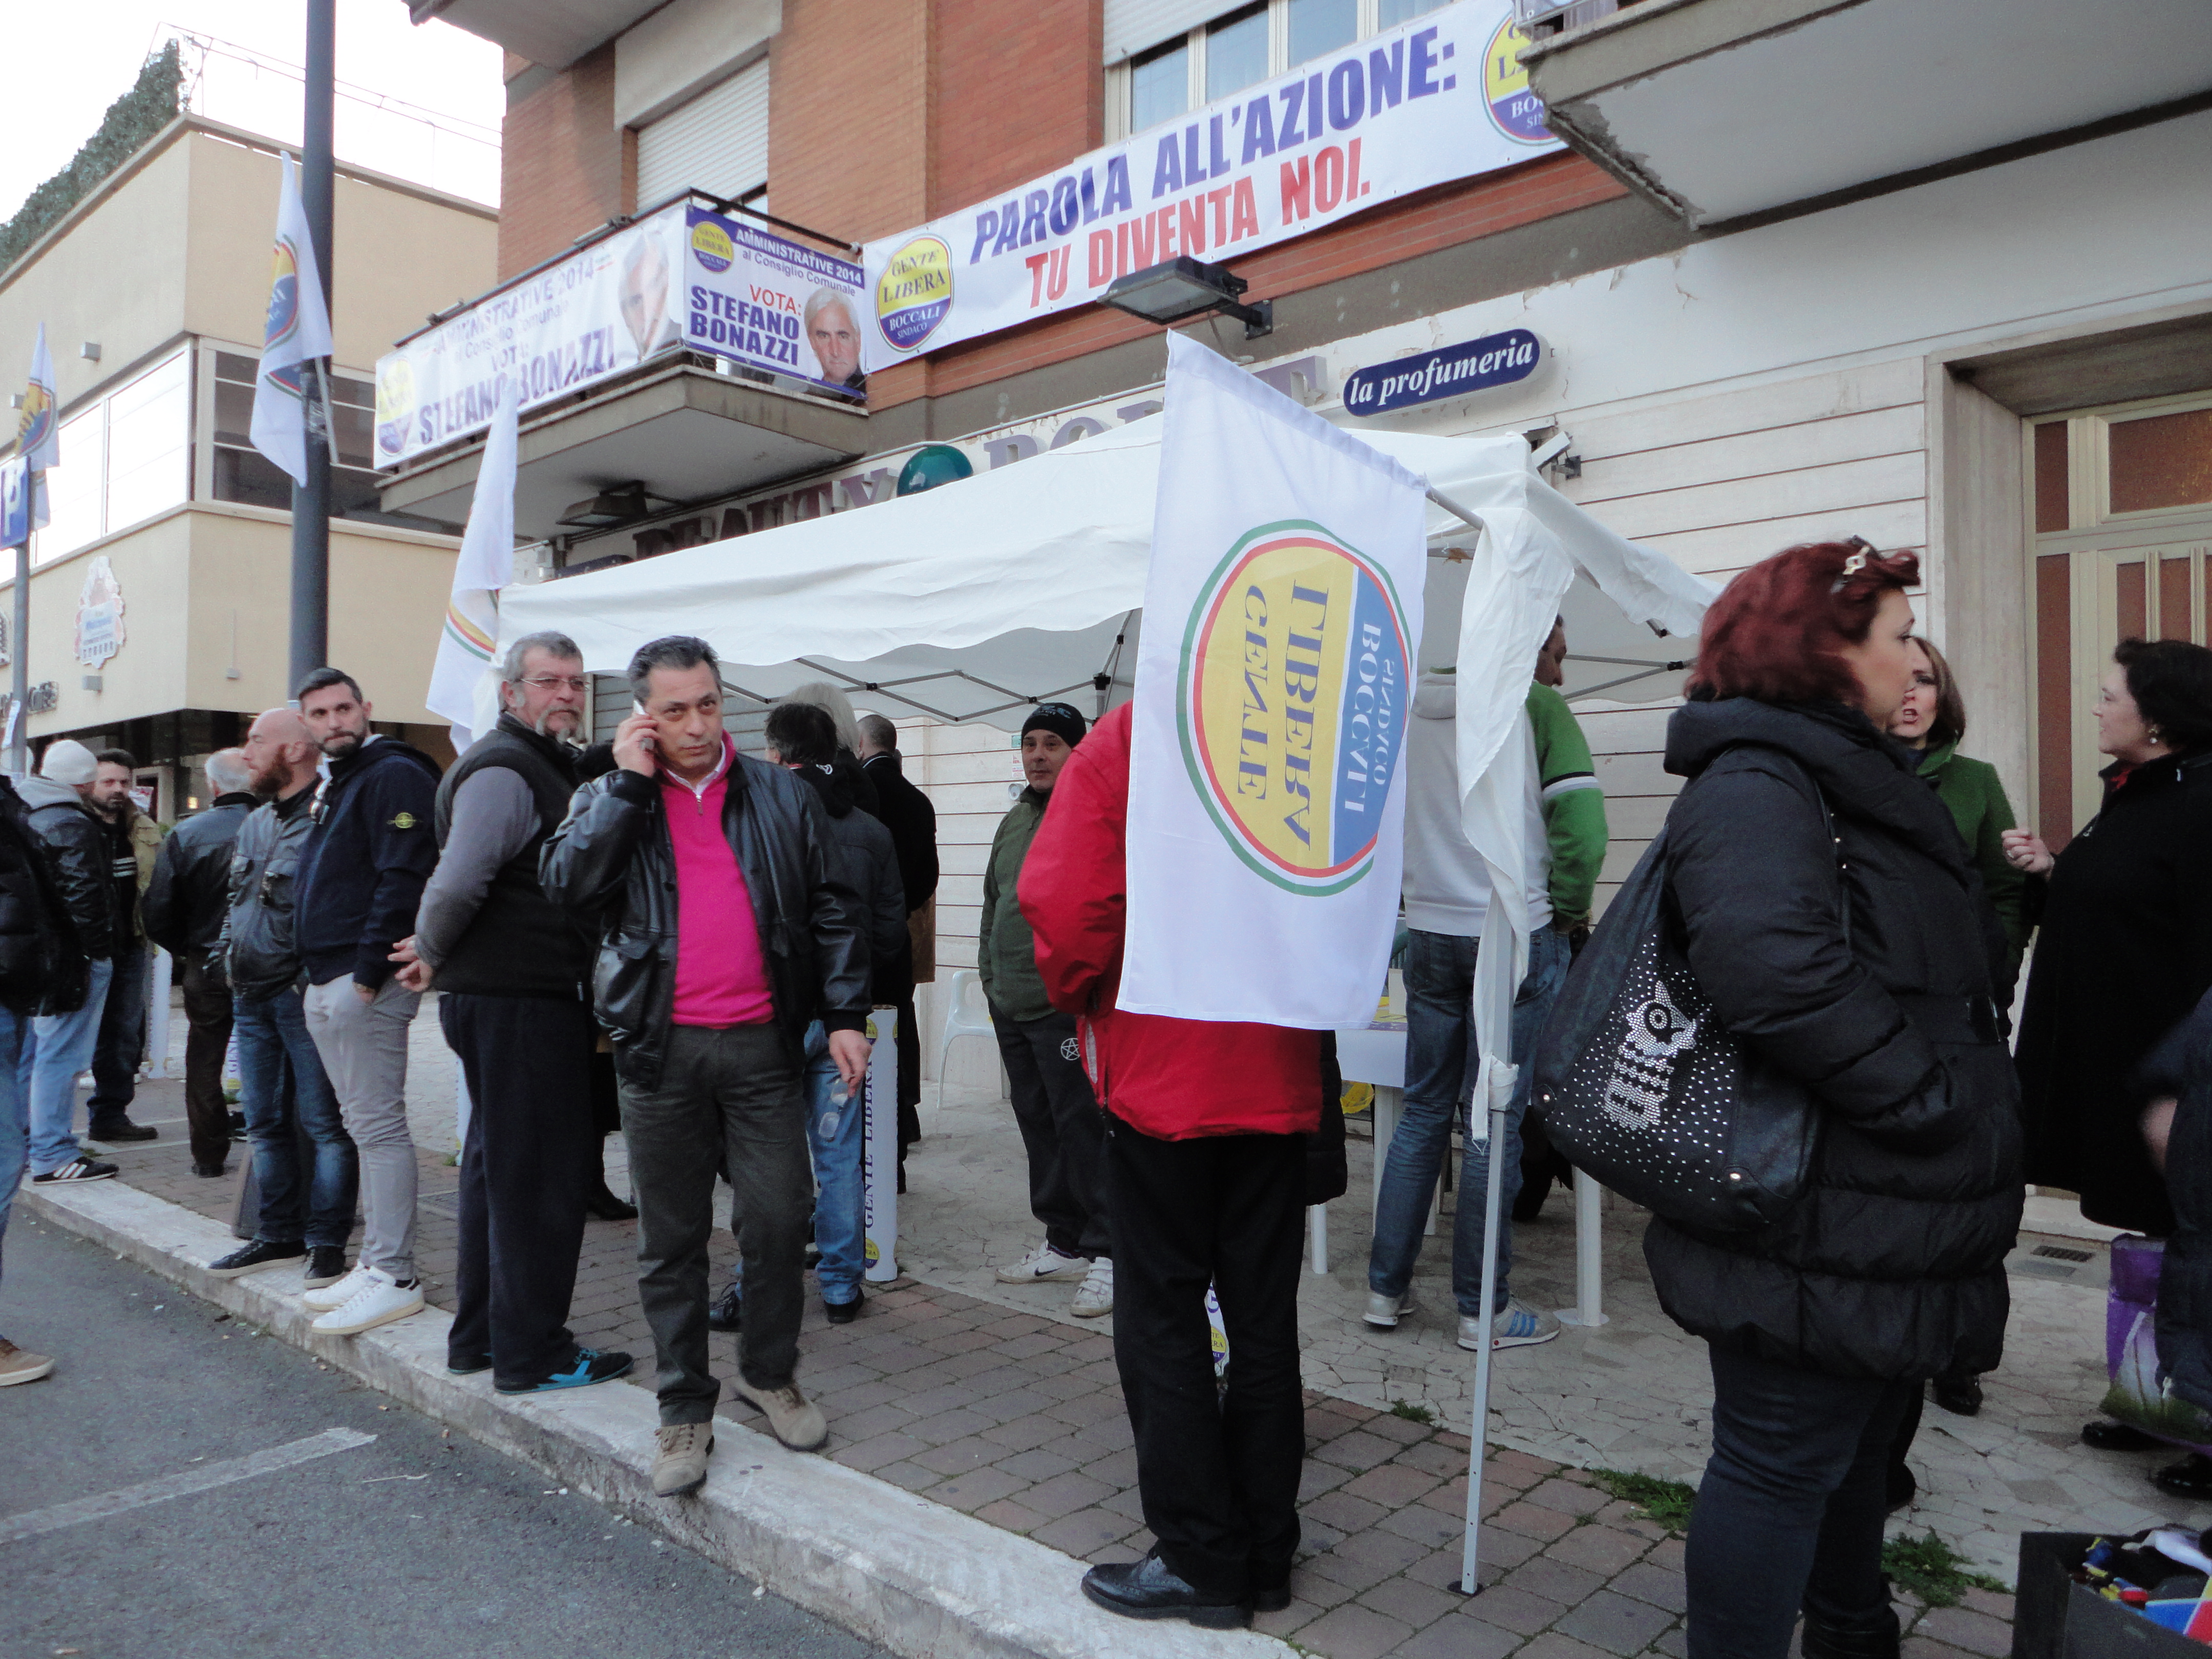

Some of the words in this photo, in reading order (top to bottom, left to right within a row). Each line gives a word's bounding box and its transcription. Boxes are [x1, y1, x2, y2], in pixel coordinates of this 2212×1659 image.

[970, 152, 1133, 265] PAROLA
[1152, 27, 1457, 200] ALL'AZIONE:
[1026, 244, 1072, 308] TU
[1088, 176, 1260, 289] DIVENTA
[1280, 136, 1371, 226] NOI.
[736, 228, 834, 273] AMMINISTRATIVE
[836, 266, 863, 285] 2014
[742, 249, 751, 262] al
[754, 251, 804, 280] Consiglio
[806, 271, 856, 297] Comunale
[891, 249, 939, 277] GENTE
[750, 283, 802, 316] VOTA:
[883, 268, 946, 303] LIBERA
[690, 310, 799, 367] BONAZZI
[691, 284, 799, 341] STEFANO
[889, 306, 940, 332] BOCCALI
[897, 322, 928, 339] SINDACO
[1350, 377, 1373, 405] la
[1377, 338, 1533, 406] profumeria
